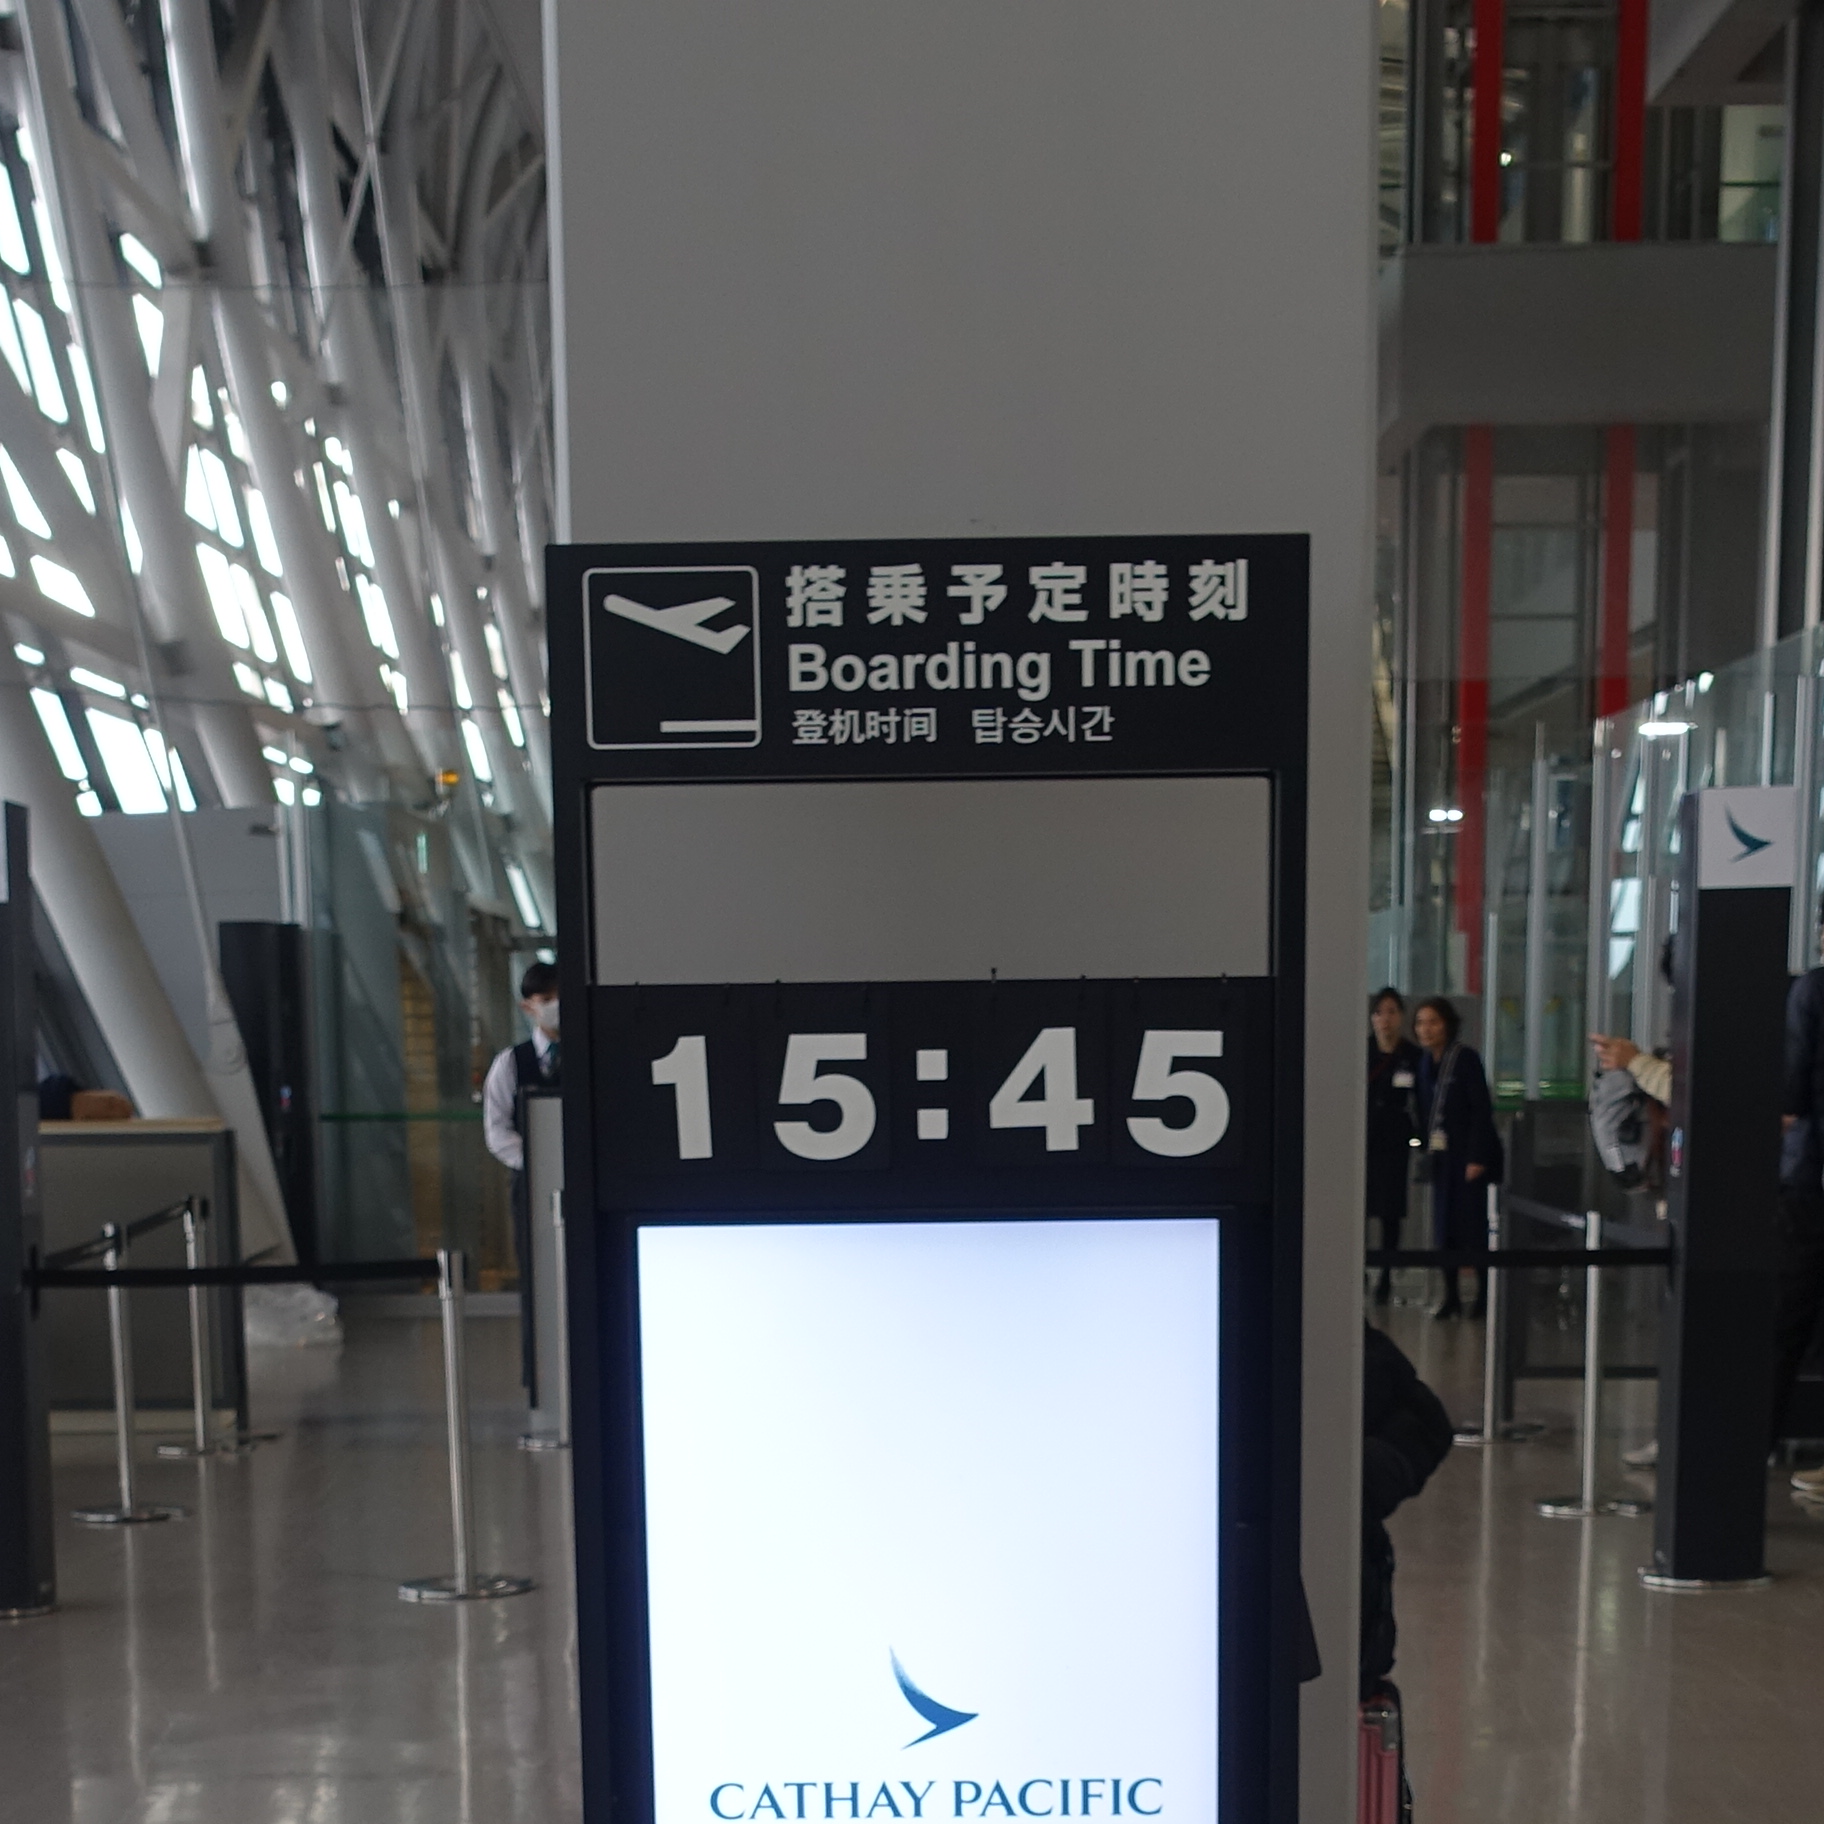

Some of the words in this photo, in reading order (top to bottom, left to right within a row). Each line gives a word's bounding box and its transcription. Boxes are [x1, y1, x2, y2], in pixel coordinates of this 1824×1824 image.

[784, 558, 1251, 629] 搭乗予定時刻
[787, 640, 1051, 702] Boarding
[1069, 637, 1212, 689] Time
[791, 707, 939, 746] 登机时间
[971, 705, 1116, 745] 탑승시간
[650, 1026, 1232, 1161] 15:45
[709, 1780, 938, 1821] CATHAY
[951, 1776, 1166, 1818] PACIFIC
